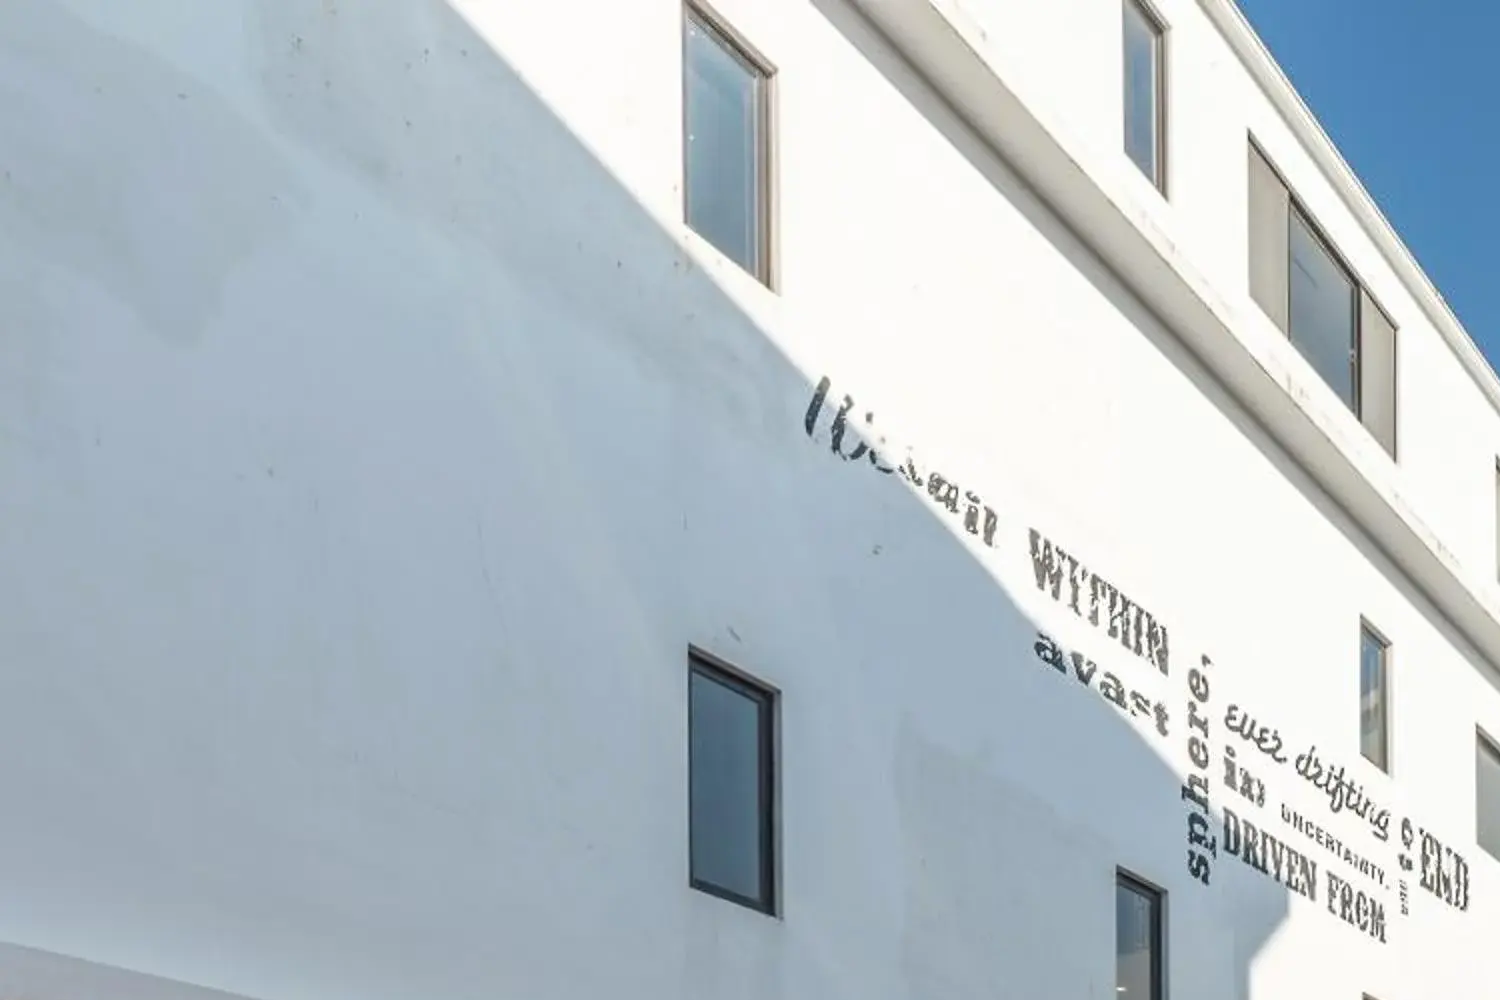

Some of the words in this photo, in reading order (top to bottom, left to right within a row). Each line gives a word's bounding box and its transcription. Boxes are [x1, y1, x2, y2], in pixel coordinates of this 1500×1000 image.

[1224, 703, 1288, 764] ever
[1295, 745, 1391, 842] drifting
[1222, 806, 1318, 902] DRIVEN
[1325, 869, 1387, 944] FROM
